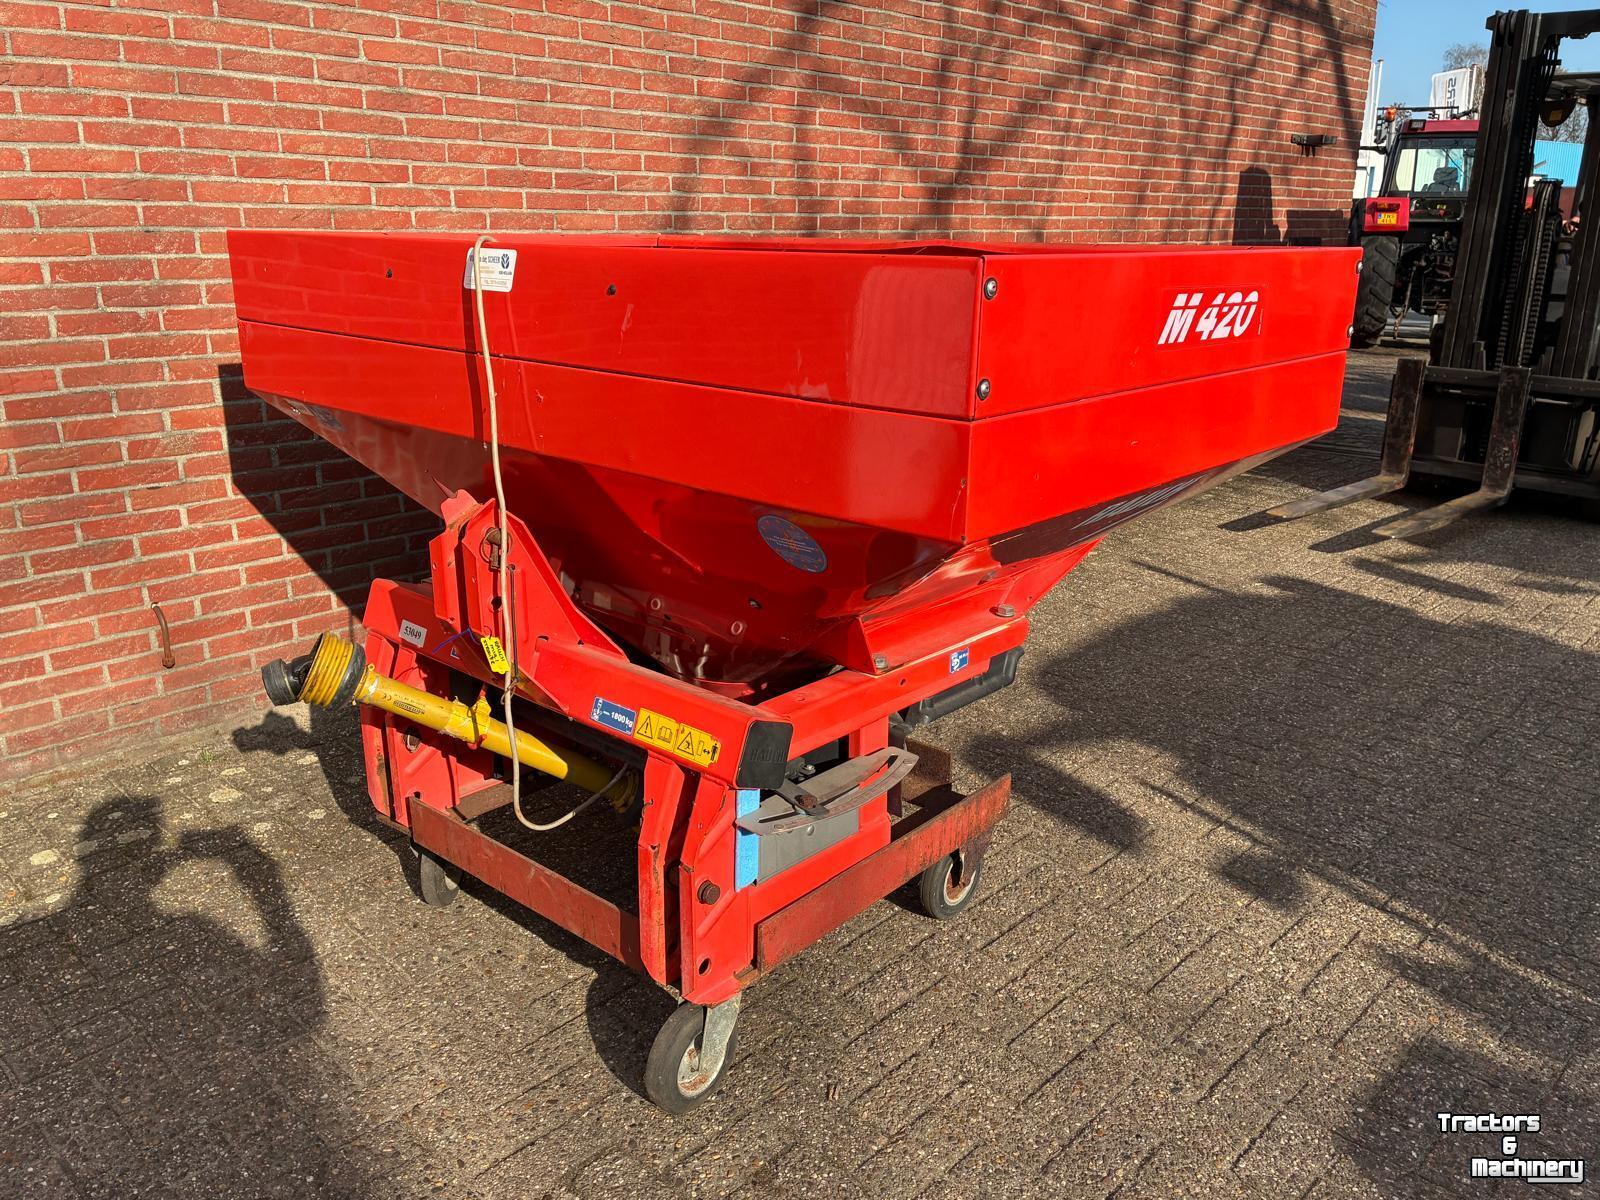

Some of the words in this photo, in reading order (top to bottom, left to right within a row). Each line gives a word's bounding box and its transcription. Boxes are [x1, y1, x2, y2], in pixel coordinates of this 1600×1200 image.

[1157, 292, 1204, 345] M
[1195, 290, 1259, 341] 420
[403, 625, 422, 640] 53049
